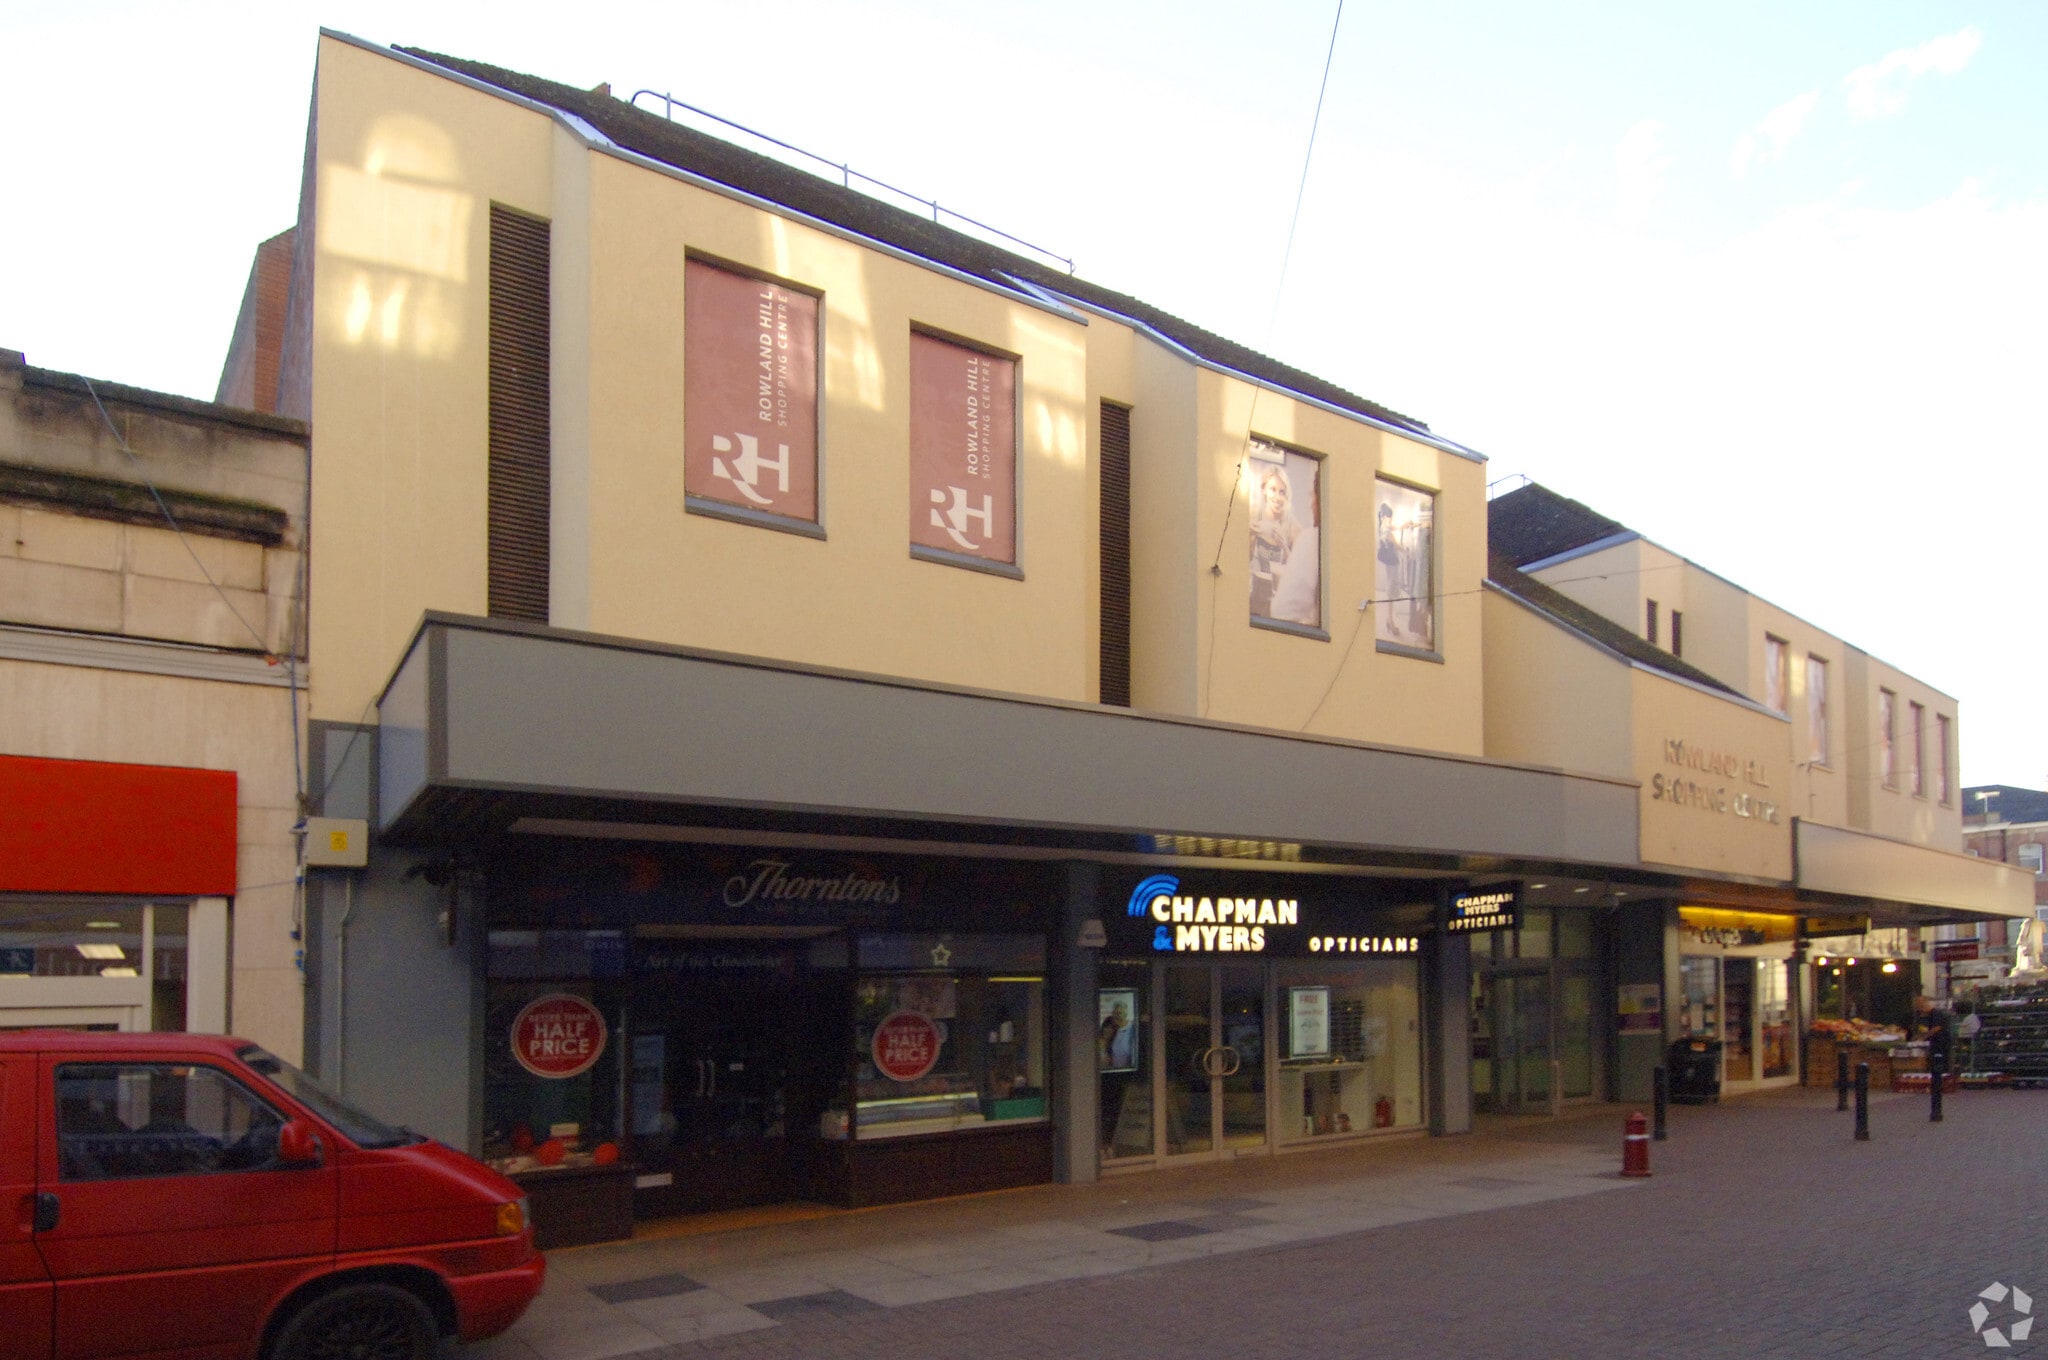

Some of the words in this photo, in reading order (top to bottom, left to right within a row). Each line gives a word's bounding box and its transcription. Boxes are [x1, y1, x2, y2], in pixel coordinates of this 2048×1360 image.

[759, 291, 773, 329] HILL
[777, 294, 789, 350] CENTRE
[759, 333, 773, 422] ROWLAND
[777, 355, 789, 427] SHOPPING
[967, 357, 979, 392] HILL
[982, 360, 992, 410] CENTRE
[967, 396, 979, 476] ROWLAND
[982, 415, 992, 480] SHOPPING
[712, 432, 790, 504] RH
[930, 485, 993, 550] RH
[723, 859, 901, 907] Thorntons
[1456, 892, 1514, 908] CHAPMAN
[1152, 895, 1298, 925] CHAPMAN
[1448, 914, 1514, 930] OPTICIANS
[1465, 903, 1501, 916] MYERS
[1153, 926, 1174, 950] &
[1176, 926, 1265, 951] MYERS
[1309, 936, 1419, 953] OPTICIANS
[529, 1038, 590, 1057] PRICE
[534, 1022, 586, 1039] HALF
[888, 1033, 926, 1048] HALF
[885, 1047, 928, 1063] PRICE
